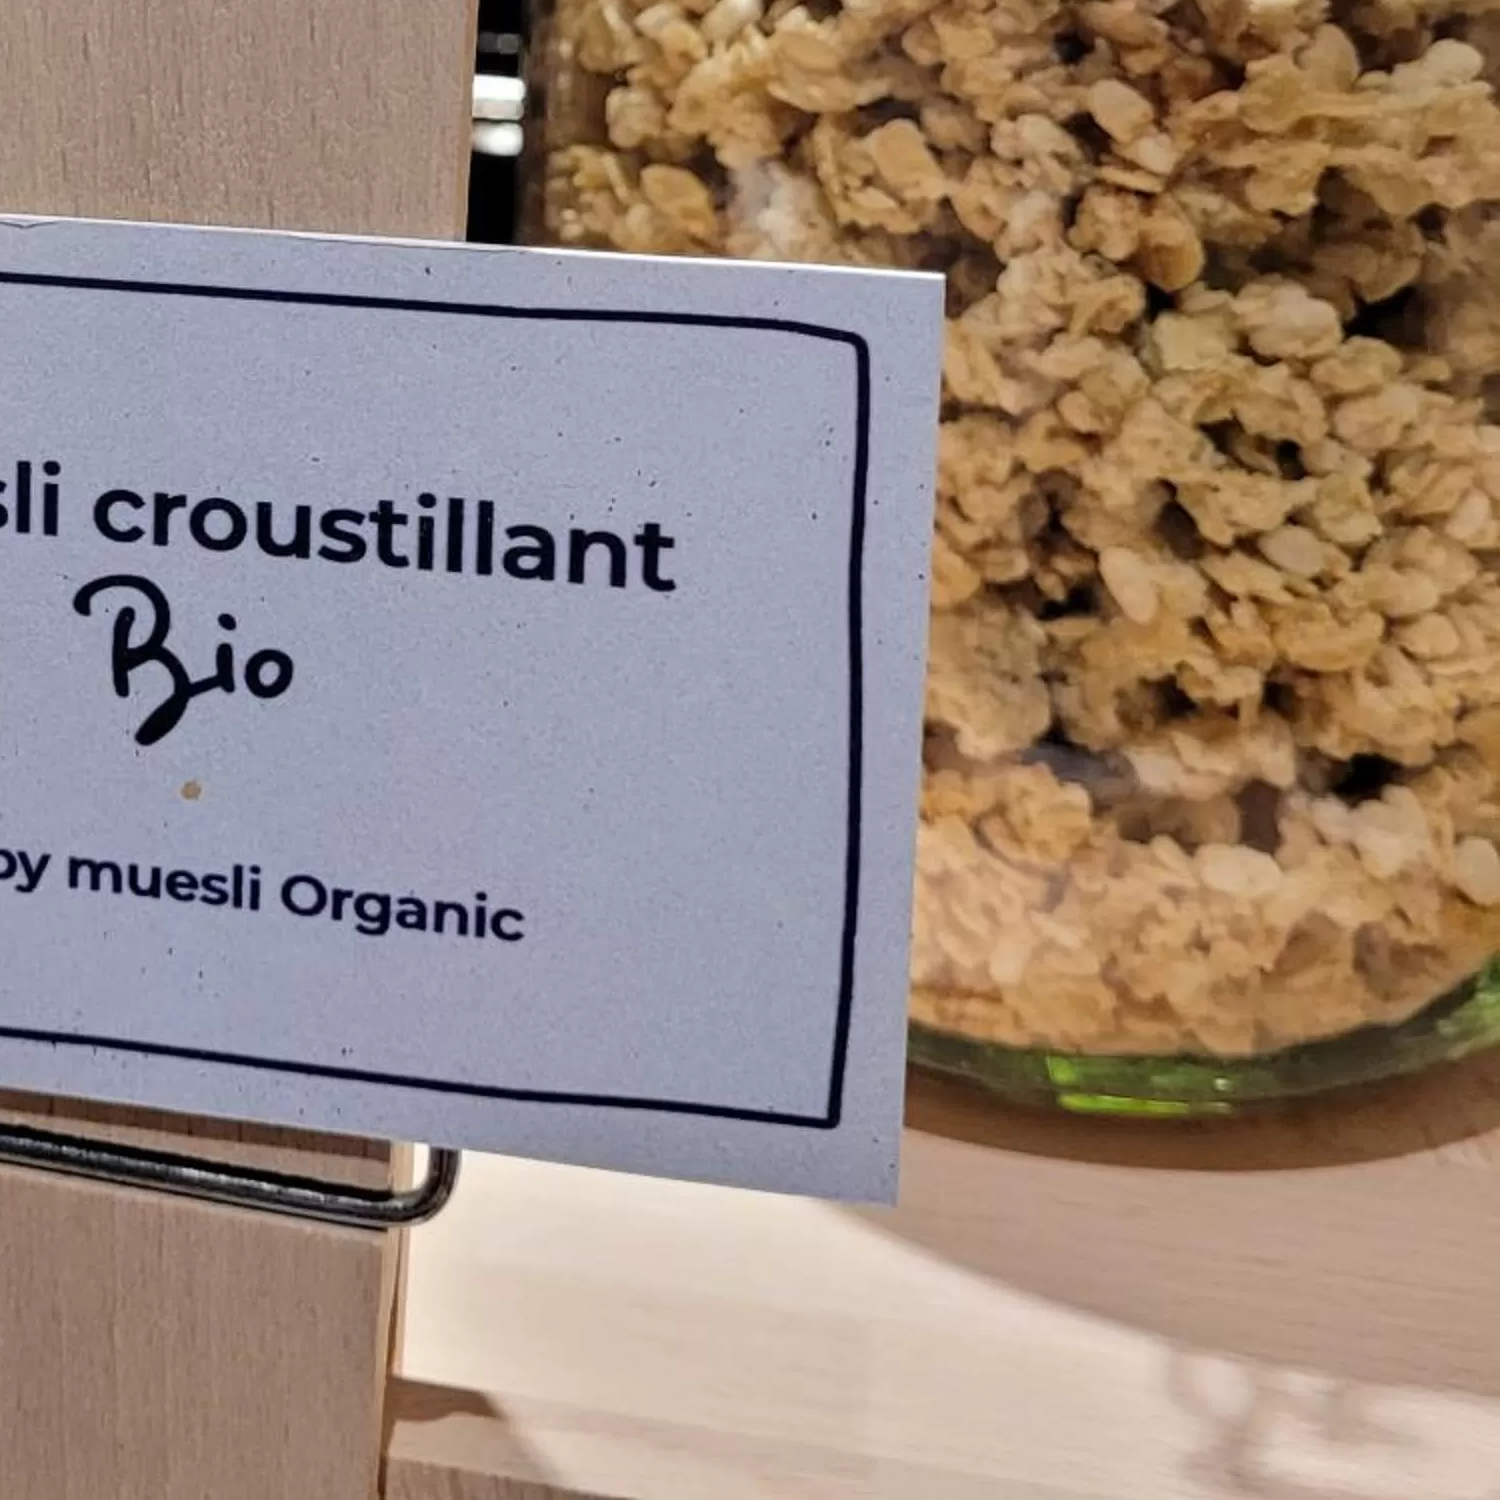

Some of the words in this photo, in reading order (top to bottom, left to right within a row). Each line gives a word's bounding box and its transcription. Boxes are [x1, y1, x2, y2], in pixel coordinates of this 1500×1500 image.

[92, 488, 678, 594] croustillant
[72, 573, 294, 748] Bio
[67, 855, 262, 913] muesli
[279, 873, 525, 943] Organic
